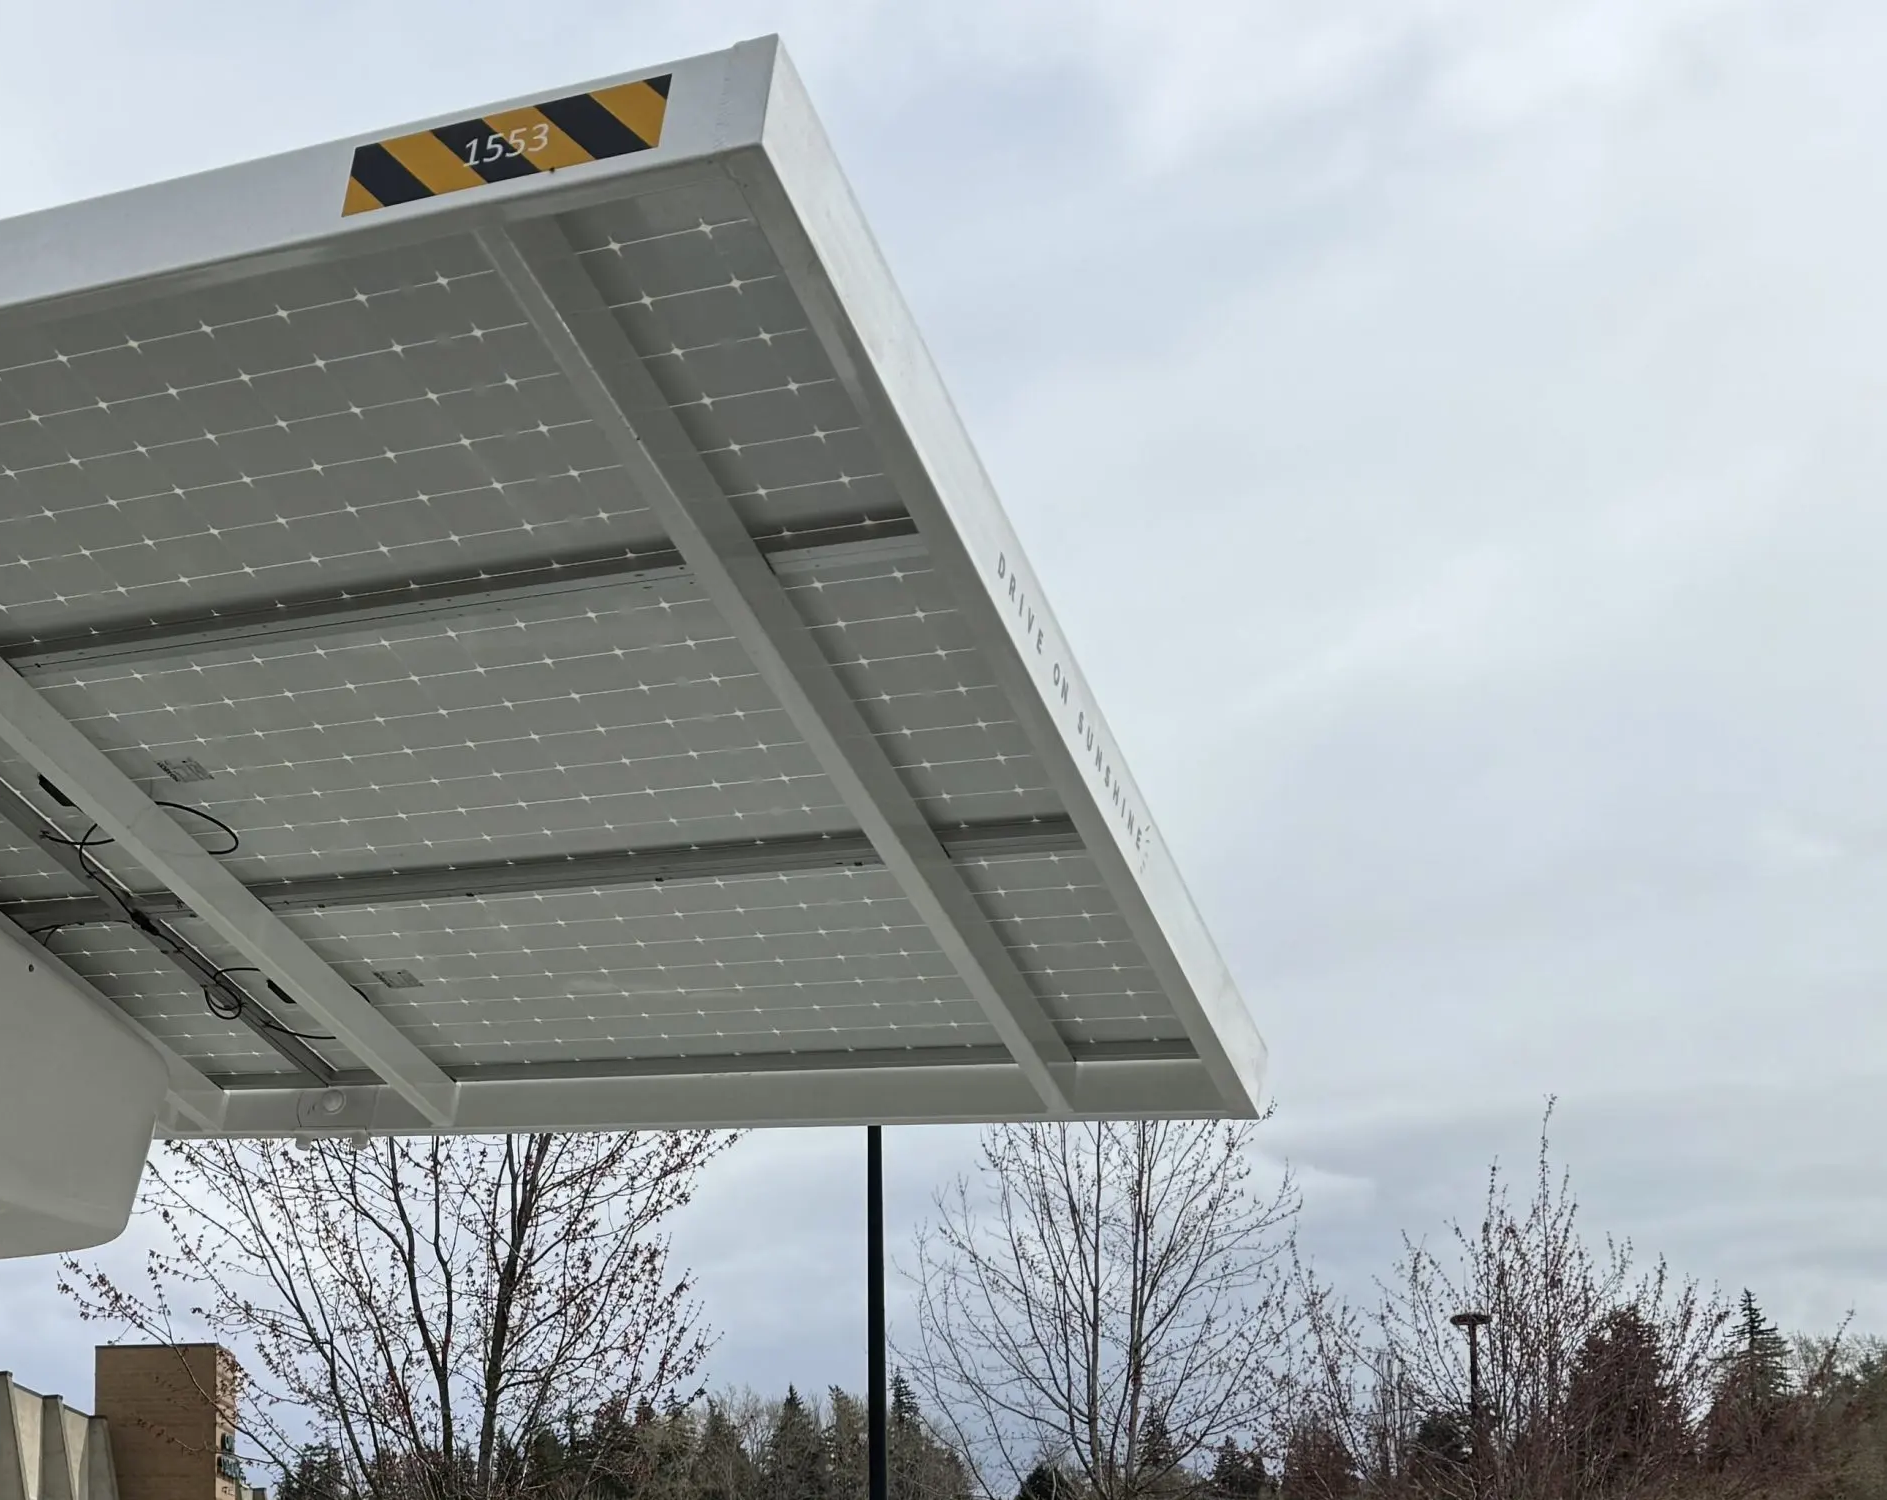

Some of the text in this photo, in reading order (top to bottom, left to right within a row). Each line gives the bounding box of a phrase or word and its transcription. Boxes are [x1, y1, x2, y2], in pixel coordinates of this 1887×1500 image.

[463, 123, 550, 168] 1553
[997, 551, 1142, 850] DRIVE ON SUNSHINE
